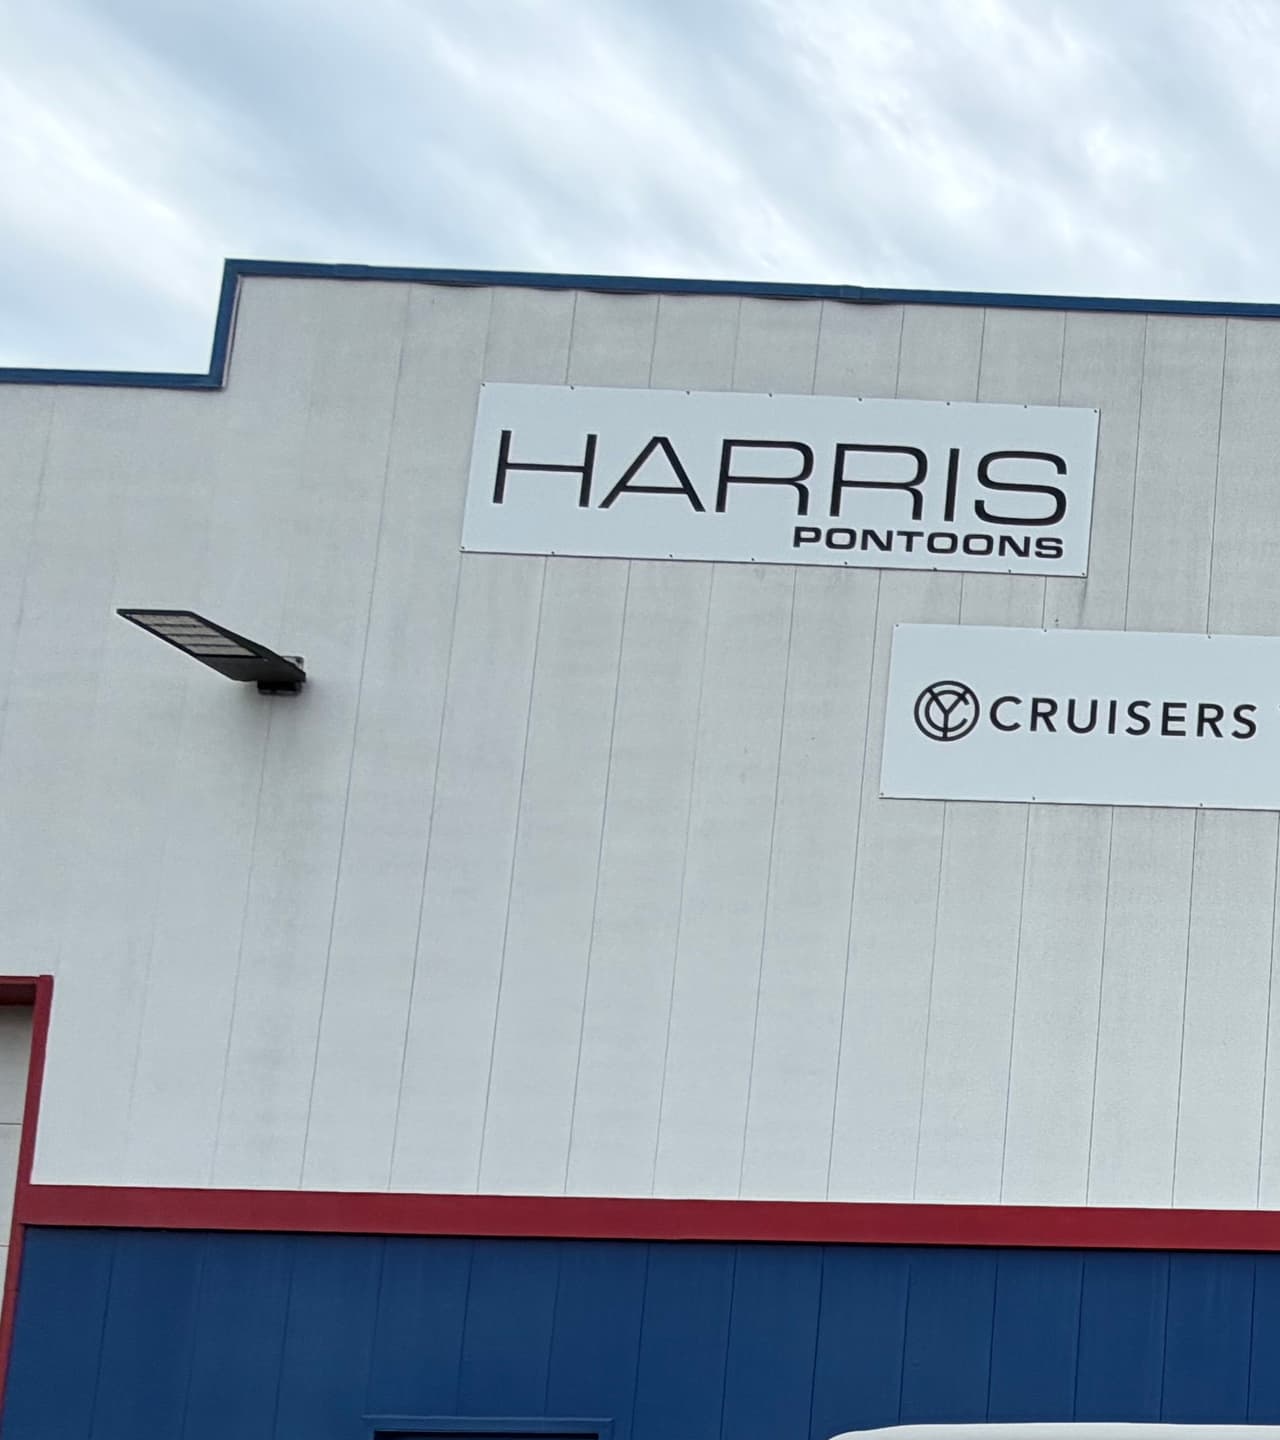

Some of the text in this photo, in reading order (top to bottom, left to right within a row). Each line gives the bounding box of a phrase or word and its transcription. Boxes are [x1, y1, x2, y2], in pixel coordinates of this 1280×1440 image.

[492, 429, 1067, 527] HARRIS
[791, 525, 1065, 560] PONTOONS
[989, 695, 1257, 739] CRUISERS
